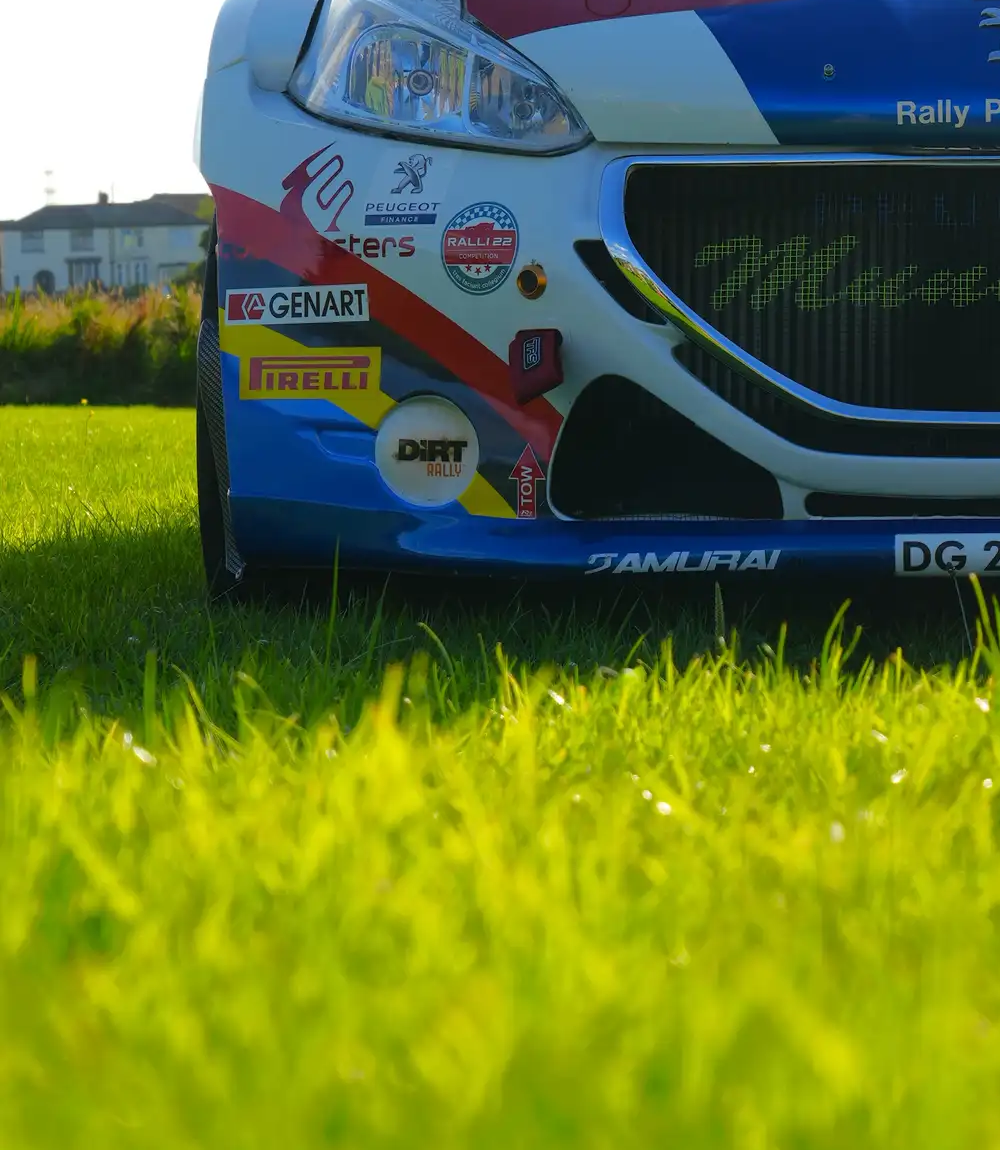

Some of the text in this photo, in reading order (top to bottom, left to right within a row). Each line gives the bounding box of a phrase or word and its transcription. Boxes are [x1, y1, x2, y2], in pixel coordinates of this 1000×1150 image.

[896, 99, 970, 128] Rally
[365, 202, 441, 212] PEUGEOT
[380, 215, 420, 224] FINANCE
[447, 236, 513, 247] RALLI 22
[268, 289, 366, 319] GENART
[249, 355, 371, 390] PIRELLI
[427, 463, 462, 477] RALLY
[520, 465, 533, 507] TOW
[902, 540, 967, 572] DG
